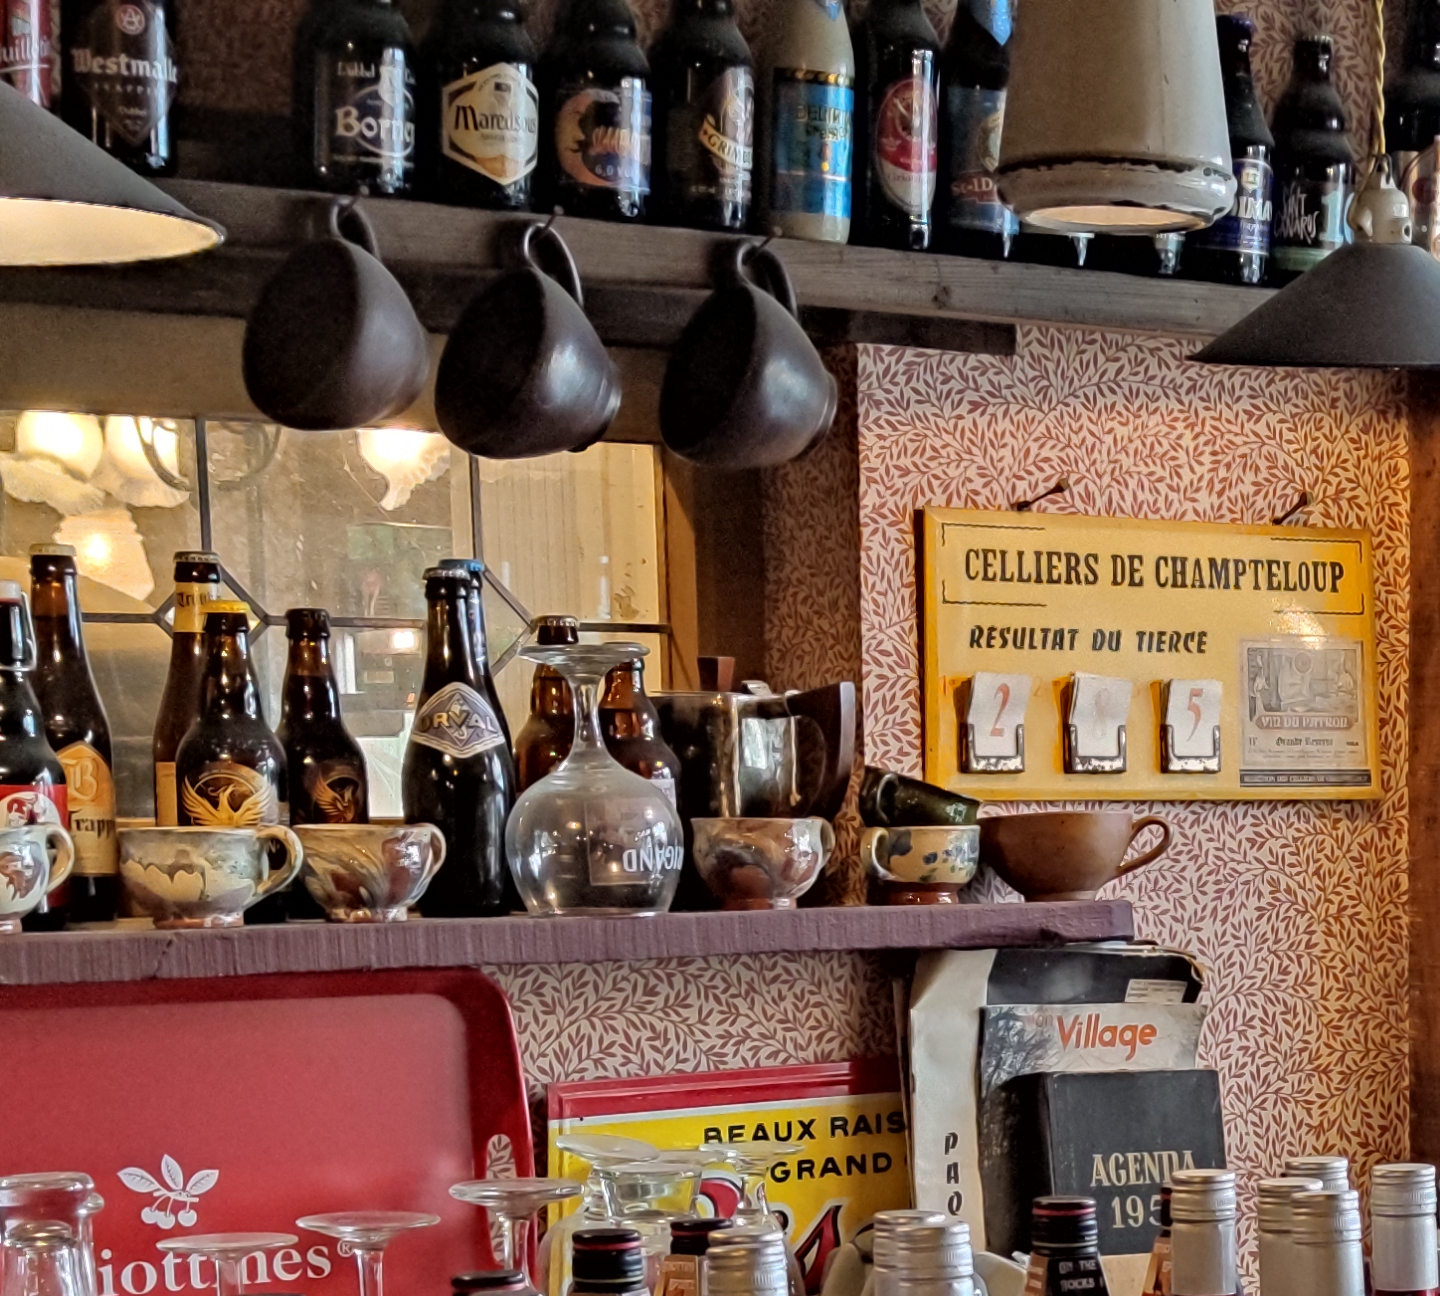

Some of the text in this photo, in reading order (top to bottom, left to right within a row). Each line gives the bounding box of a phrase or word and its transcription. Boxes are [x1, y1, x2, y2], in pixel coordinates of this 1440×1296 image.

[965, 548, 1345, 594] CELLIERS DE CHAMPTELOUP
[1091, 629, 1122, 652] DU
[421, 707, 498, 735] ORVAL
[988, 683, 1012, 738] 2
[1187, 687, 1204, 742] 5
[1284, 716, 1300, 729] DU
[1057, 1014, 1158, 1062] Village
[703, 1117, 814, 1148] BEAUX
[769, 1152, 892, 1183] GRAND
[1090, 1150, 1197, 1187] AGENDA
[1078, 1259, 1098, 1271] THE
